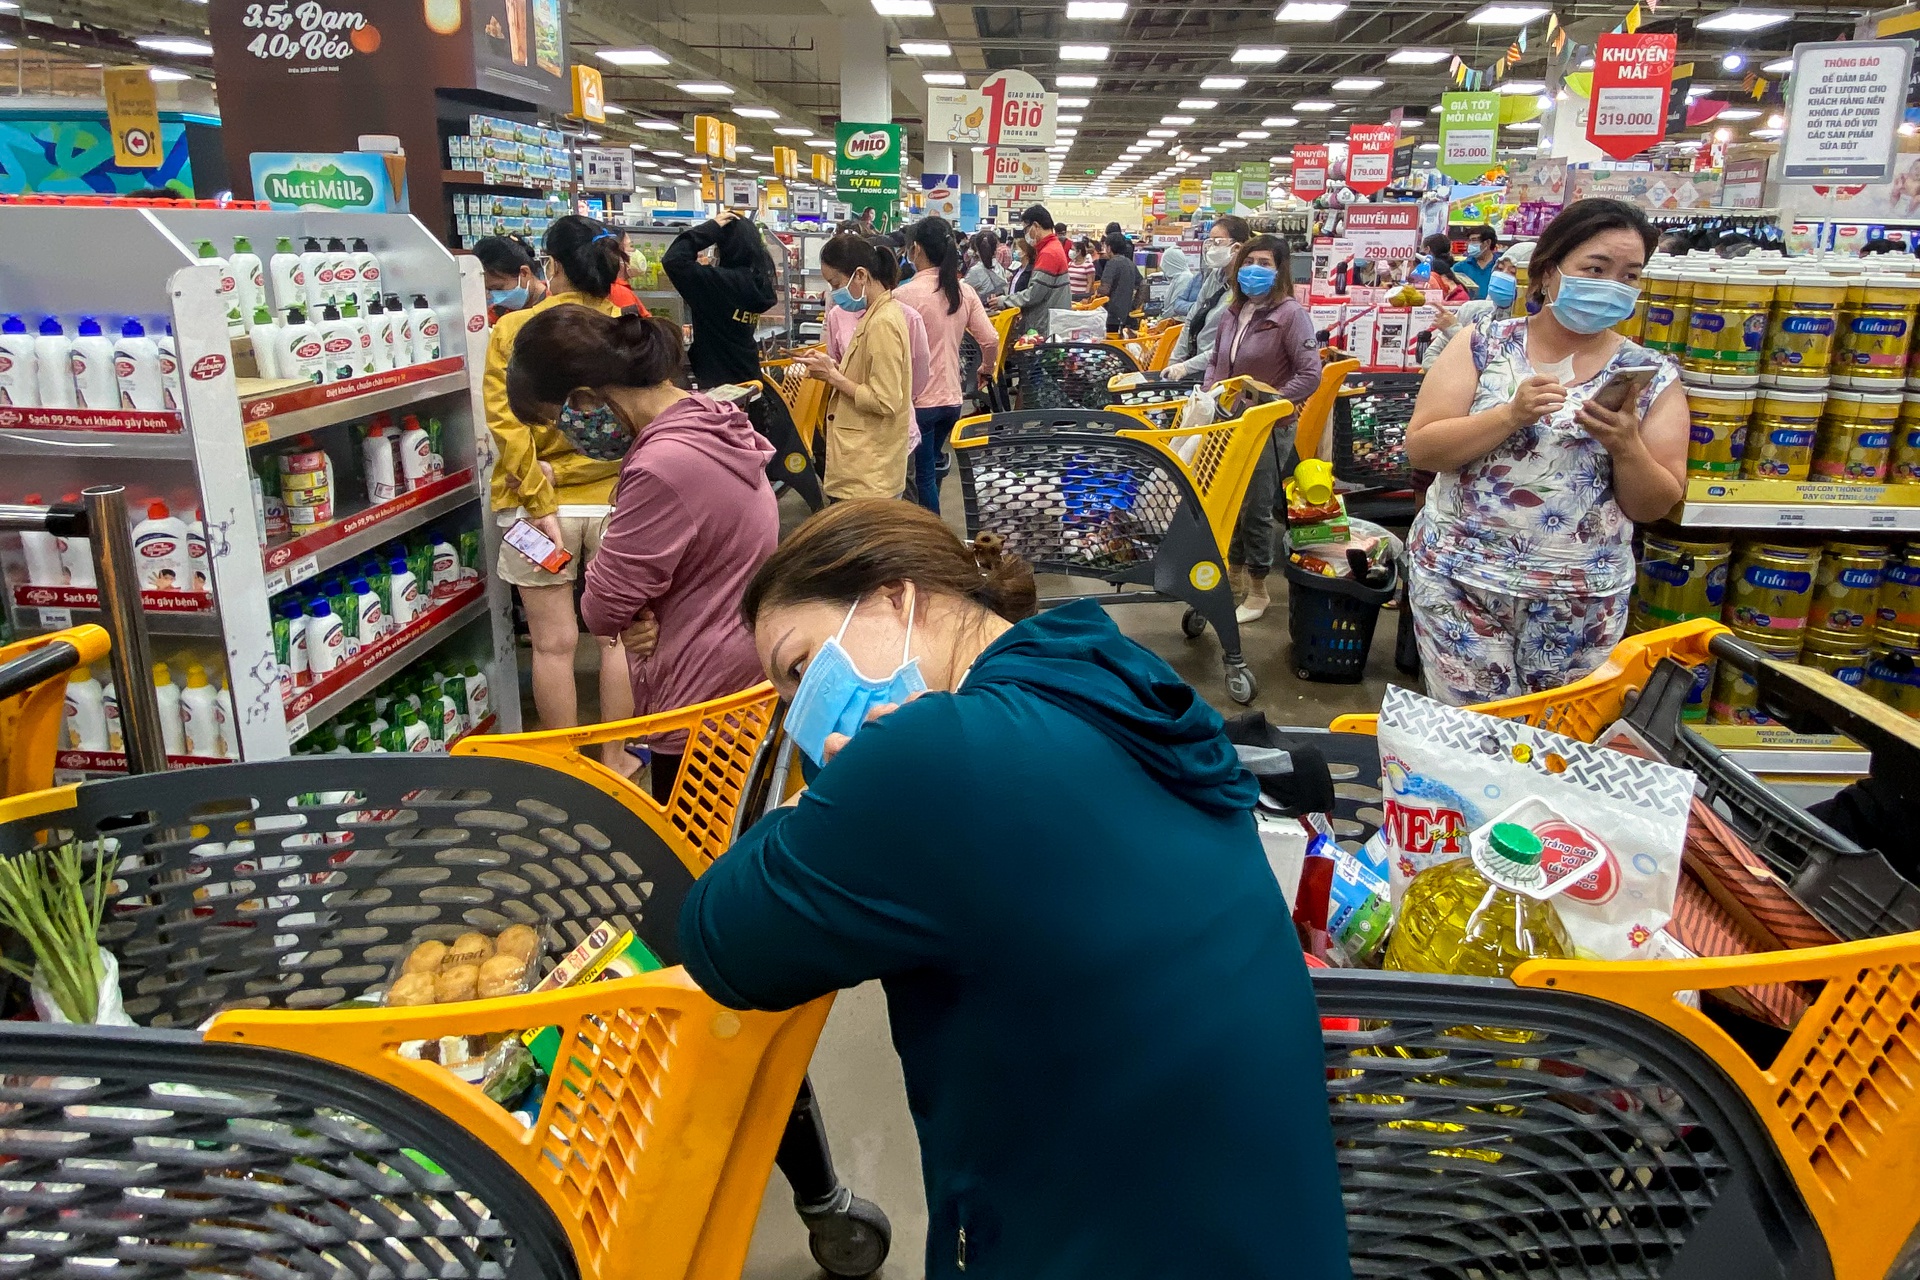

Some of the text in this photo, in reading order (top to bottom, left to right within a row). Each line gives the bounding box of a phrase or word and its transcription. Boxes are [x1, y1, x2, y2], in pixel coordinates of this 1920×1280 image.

[295, 1, 367, 33] Đạm
[247, 31, 353, 60] 4,0g Béo
[1602, 45, 1668, 62] KHUYẾN
[1824, 57, 1880, 68] THÔNG BÁO
[1618, 63, 1648, 79] MÃI
[1809, 85, 1832, 95] CHẤT
[1868, 84, 1887, 93] CHO
[1451, 100, 1491, 110] GIÁ TỐT
[1808, 95, 1885, 106] KHÁCH HÀNG NÊN
[982, 78, 1006, 145] 1
[1004, 100, 1044, 127] Giờ
[1467, 112, 1494, 122] NGÀY
[1808, 107, 1839, 117] KHÔNG
[1599, 113, 1652, 125] 319.000
[1352, 132, 1391, 141] KHUYẾN
[1807, 129, 1825, 139] CÁC
[851, 139, 886, 152] MILO
[1362, 141, 1380, 151] MÃI
[1819, 141, 1858, 151] SỮA BỘT
[1448, 148, 1486, 157] 125.000
[996, 157, 1019, 173] Giờ
[854, 168, 868, 176] SỨC
[850, 178, 882, 188] TỰ TIN
[271, 178, 365, 201] NutiMilk
[1349, 211, 1409, 224] KHUYẾN MÃI
[1364, 247, 1412, 258] 299.000
[1713, 350, 1722, 359] 4
[28, 413, 50, 425] Sạch
[50, 414, 83, 426] 99,9%
[83, 415, 94, 425] vi
[93, 414, 123, 427] khuẩn
[124, 416, 142, 429] gây
[143, 417, 168, 429] bệnh
[1702, 461, 1711, 470] 4
[63, 592, 85, 603] Sạch
[157, 595, 176, 608] gây
[176, 597, 198, 608] bệnh
[1384, 799, 1466, 854] NET
[1542, 837, 1571, 853] Trắng
